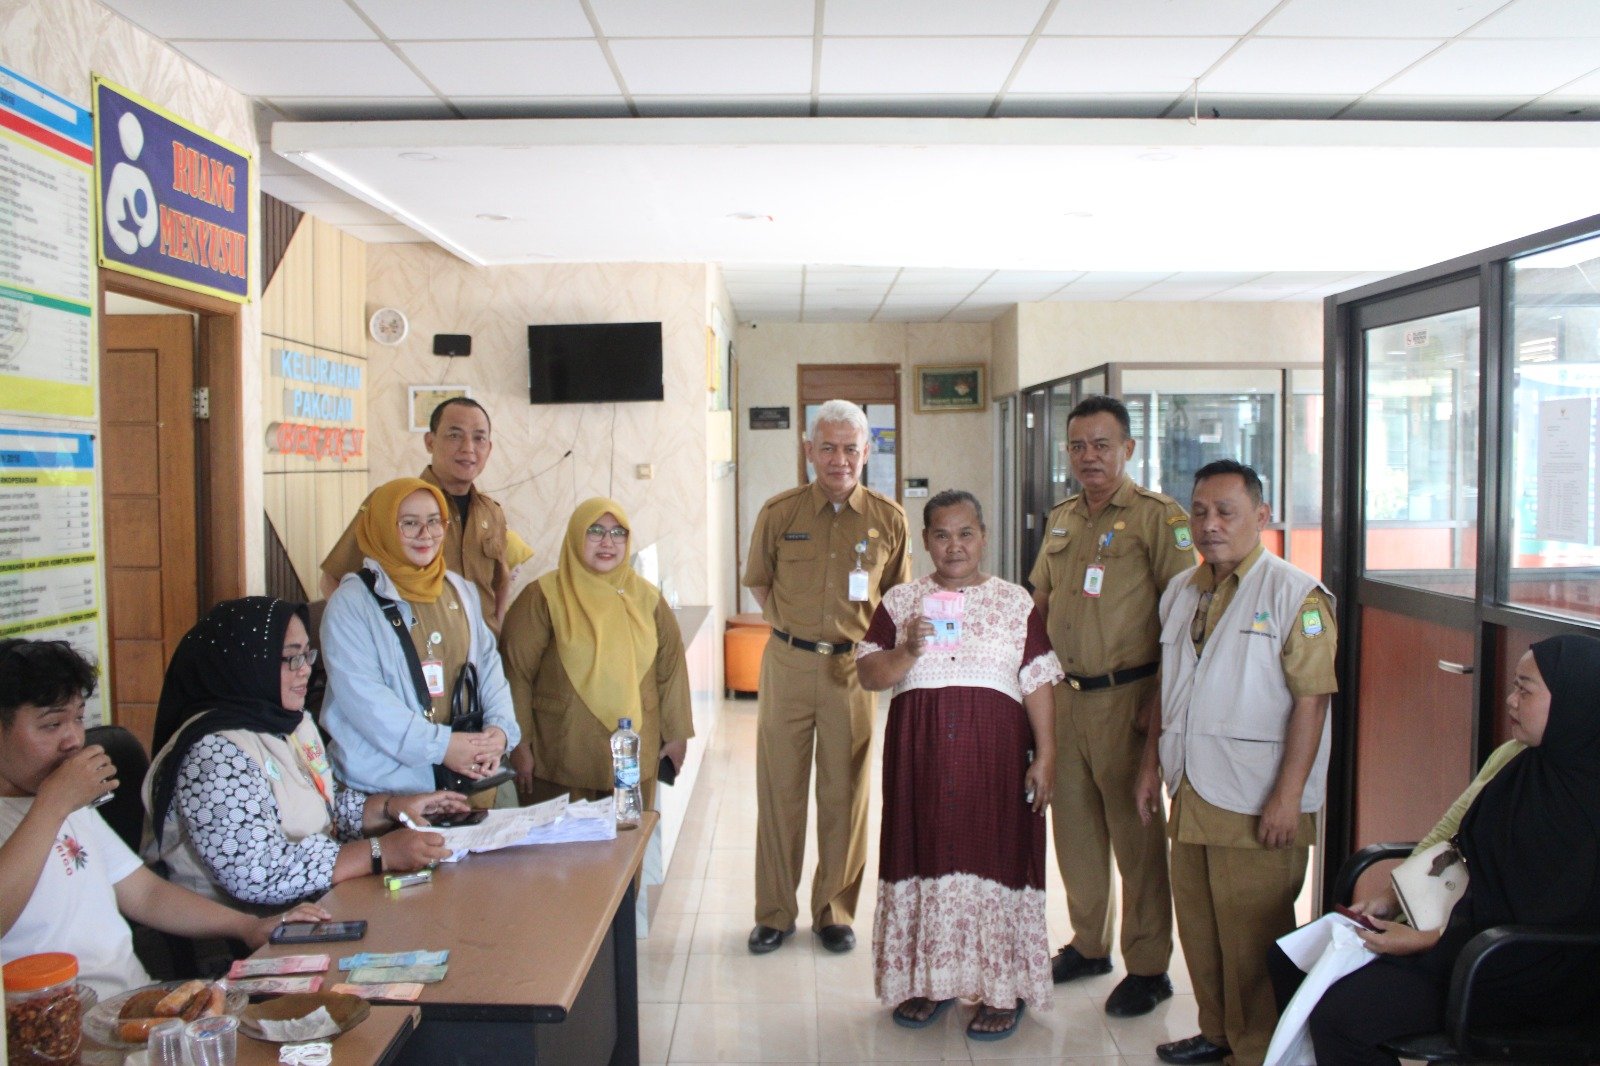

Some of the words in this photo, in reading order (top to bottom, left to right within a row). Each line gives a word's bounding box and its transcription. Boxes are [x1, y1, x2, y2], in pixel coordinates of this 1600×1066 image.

[172, 140, 235, 213] RUANG
[159, 203, 246, 279] MENYUSUI
[281, 350, 362, 390] KELURAHAN
